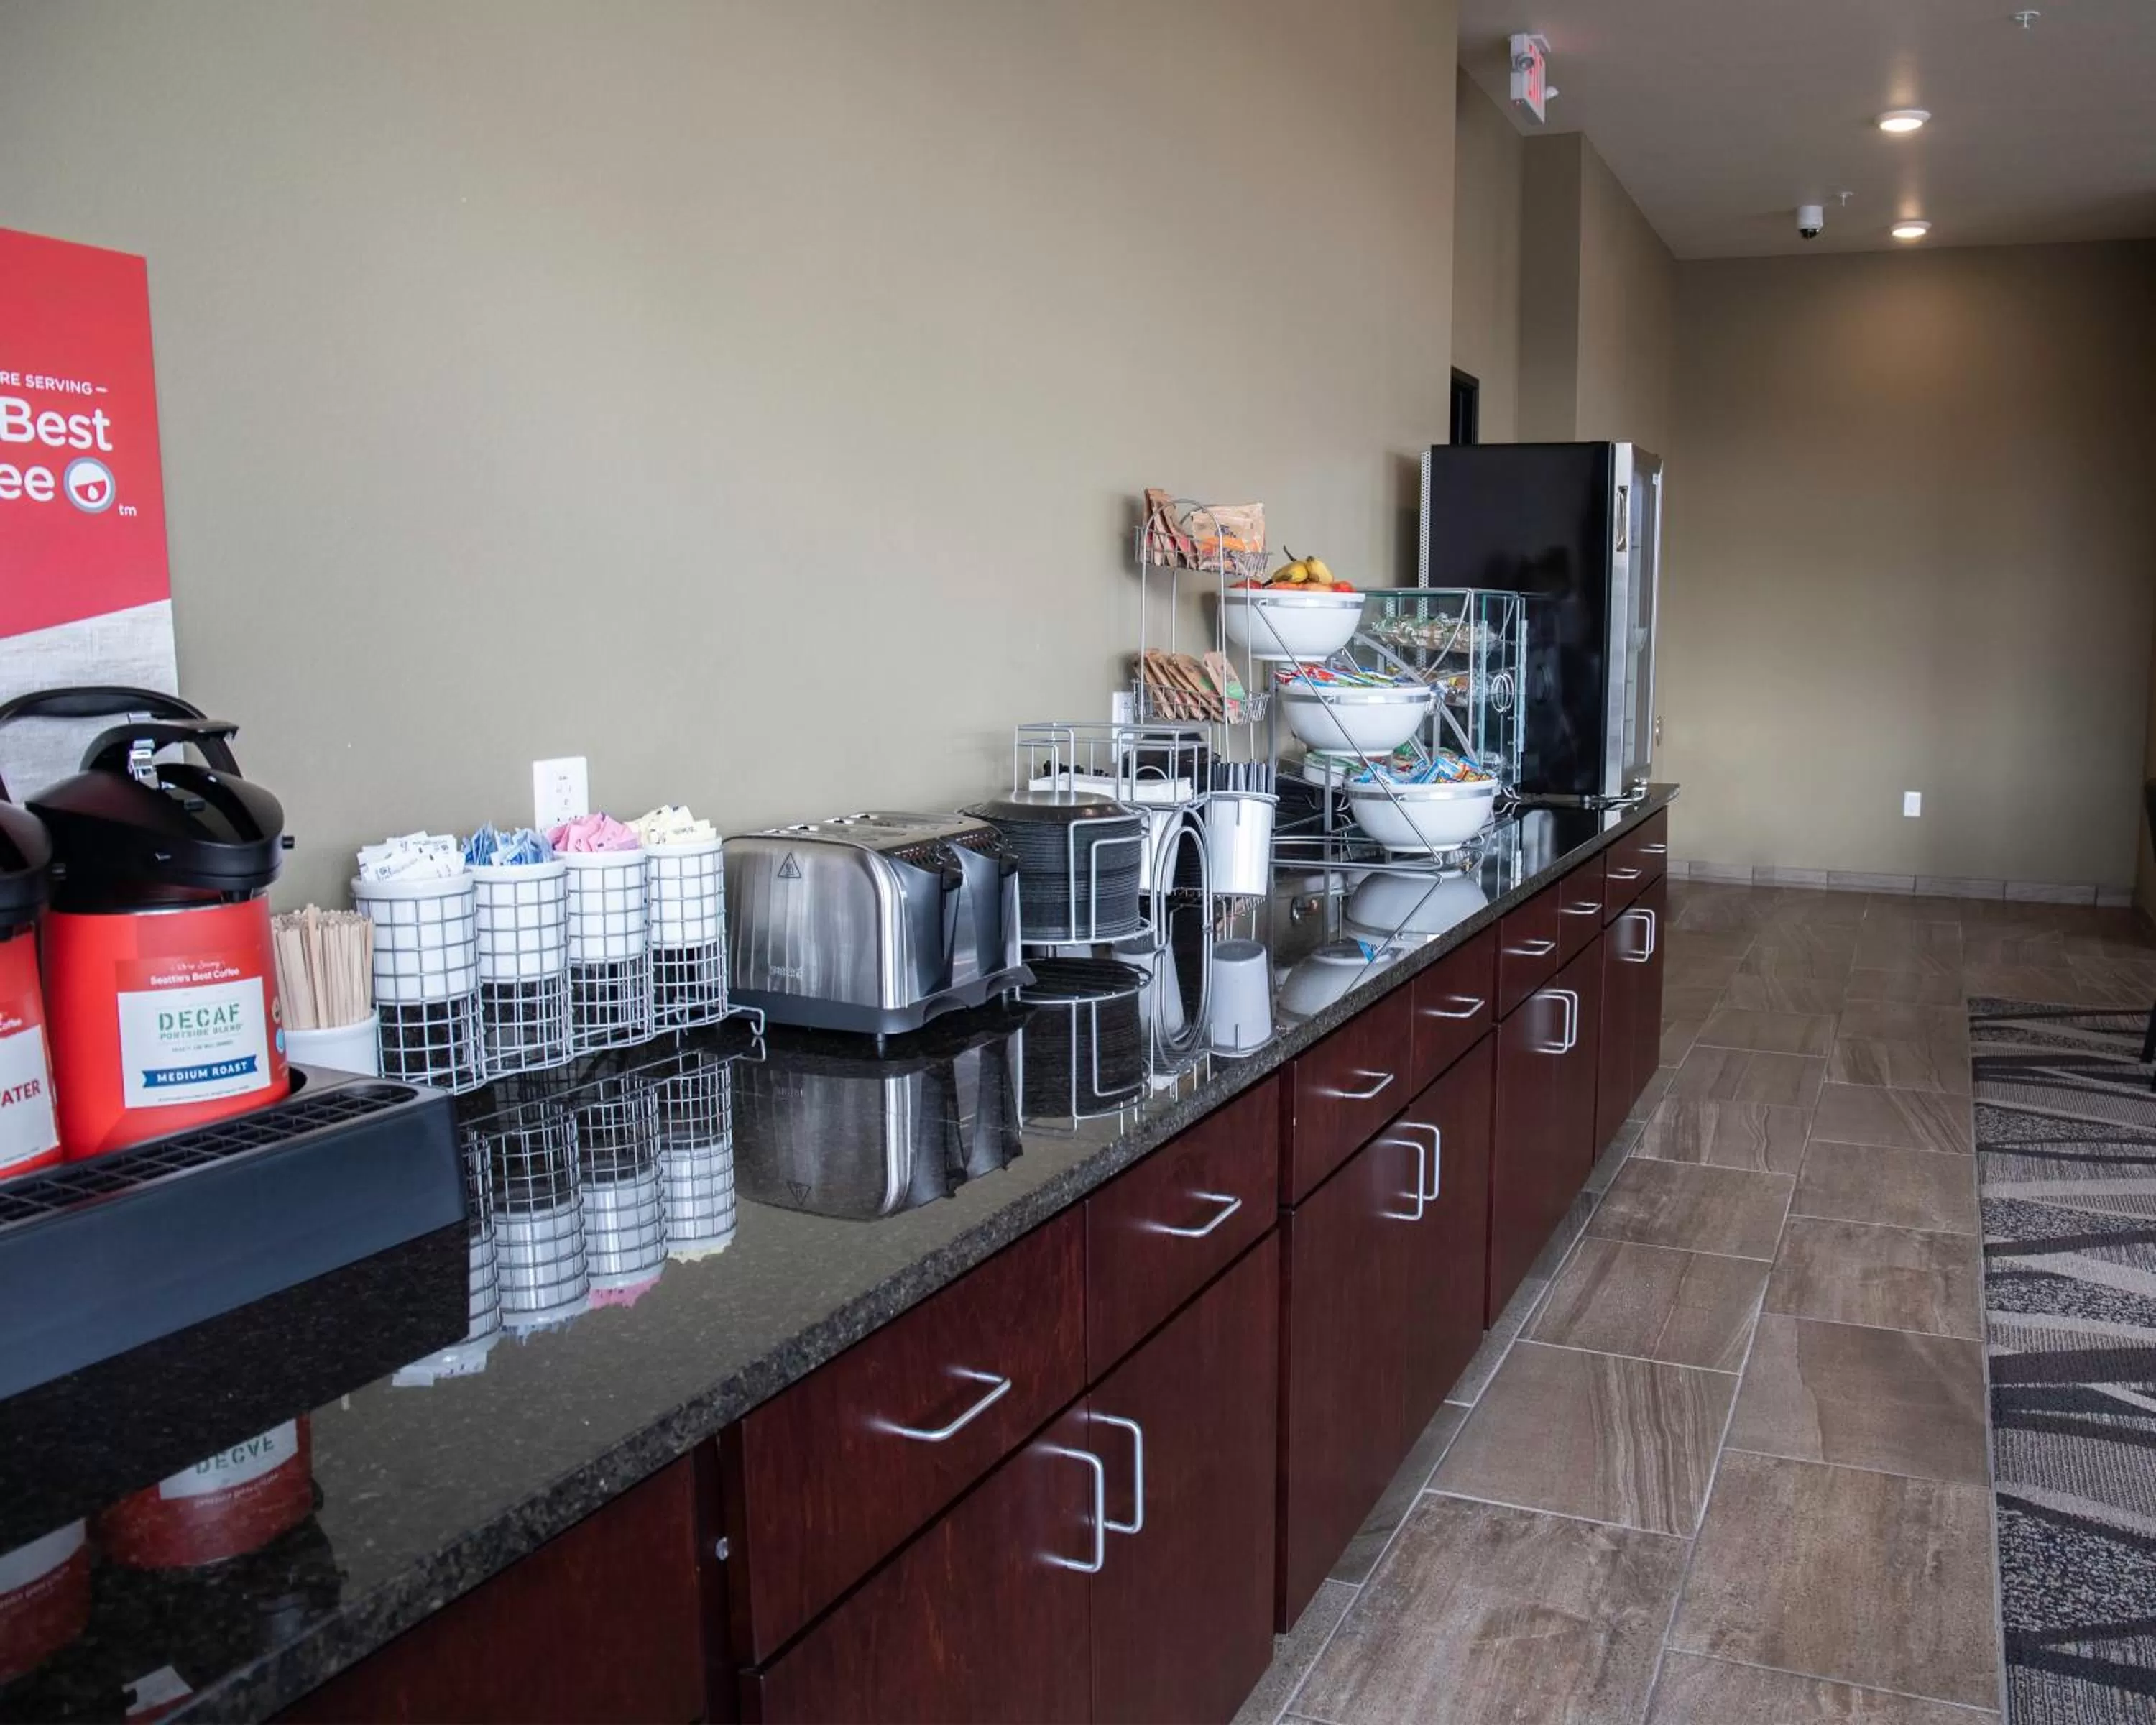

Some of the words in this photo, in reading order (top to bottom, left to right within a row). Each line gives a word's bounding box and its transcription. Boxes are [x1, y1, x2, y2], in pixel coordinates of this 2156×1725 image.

[25, 374, 93, 395] SERVING
[0, 396, 113, 451] Best
[158, 1003, 240, 1031] DECAF
[157, 1068, 208, 1082] MEDIUM
[212, 1061, 248, 1075] ROAST
[0, 1078, 41, 1108] ATER
